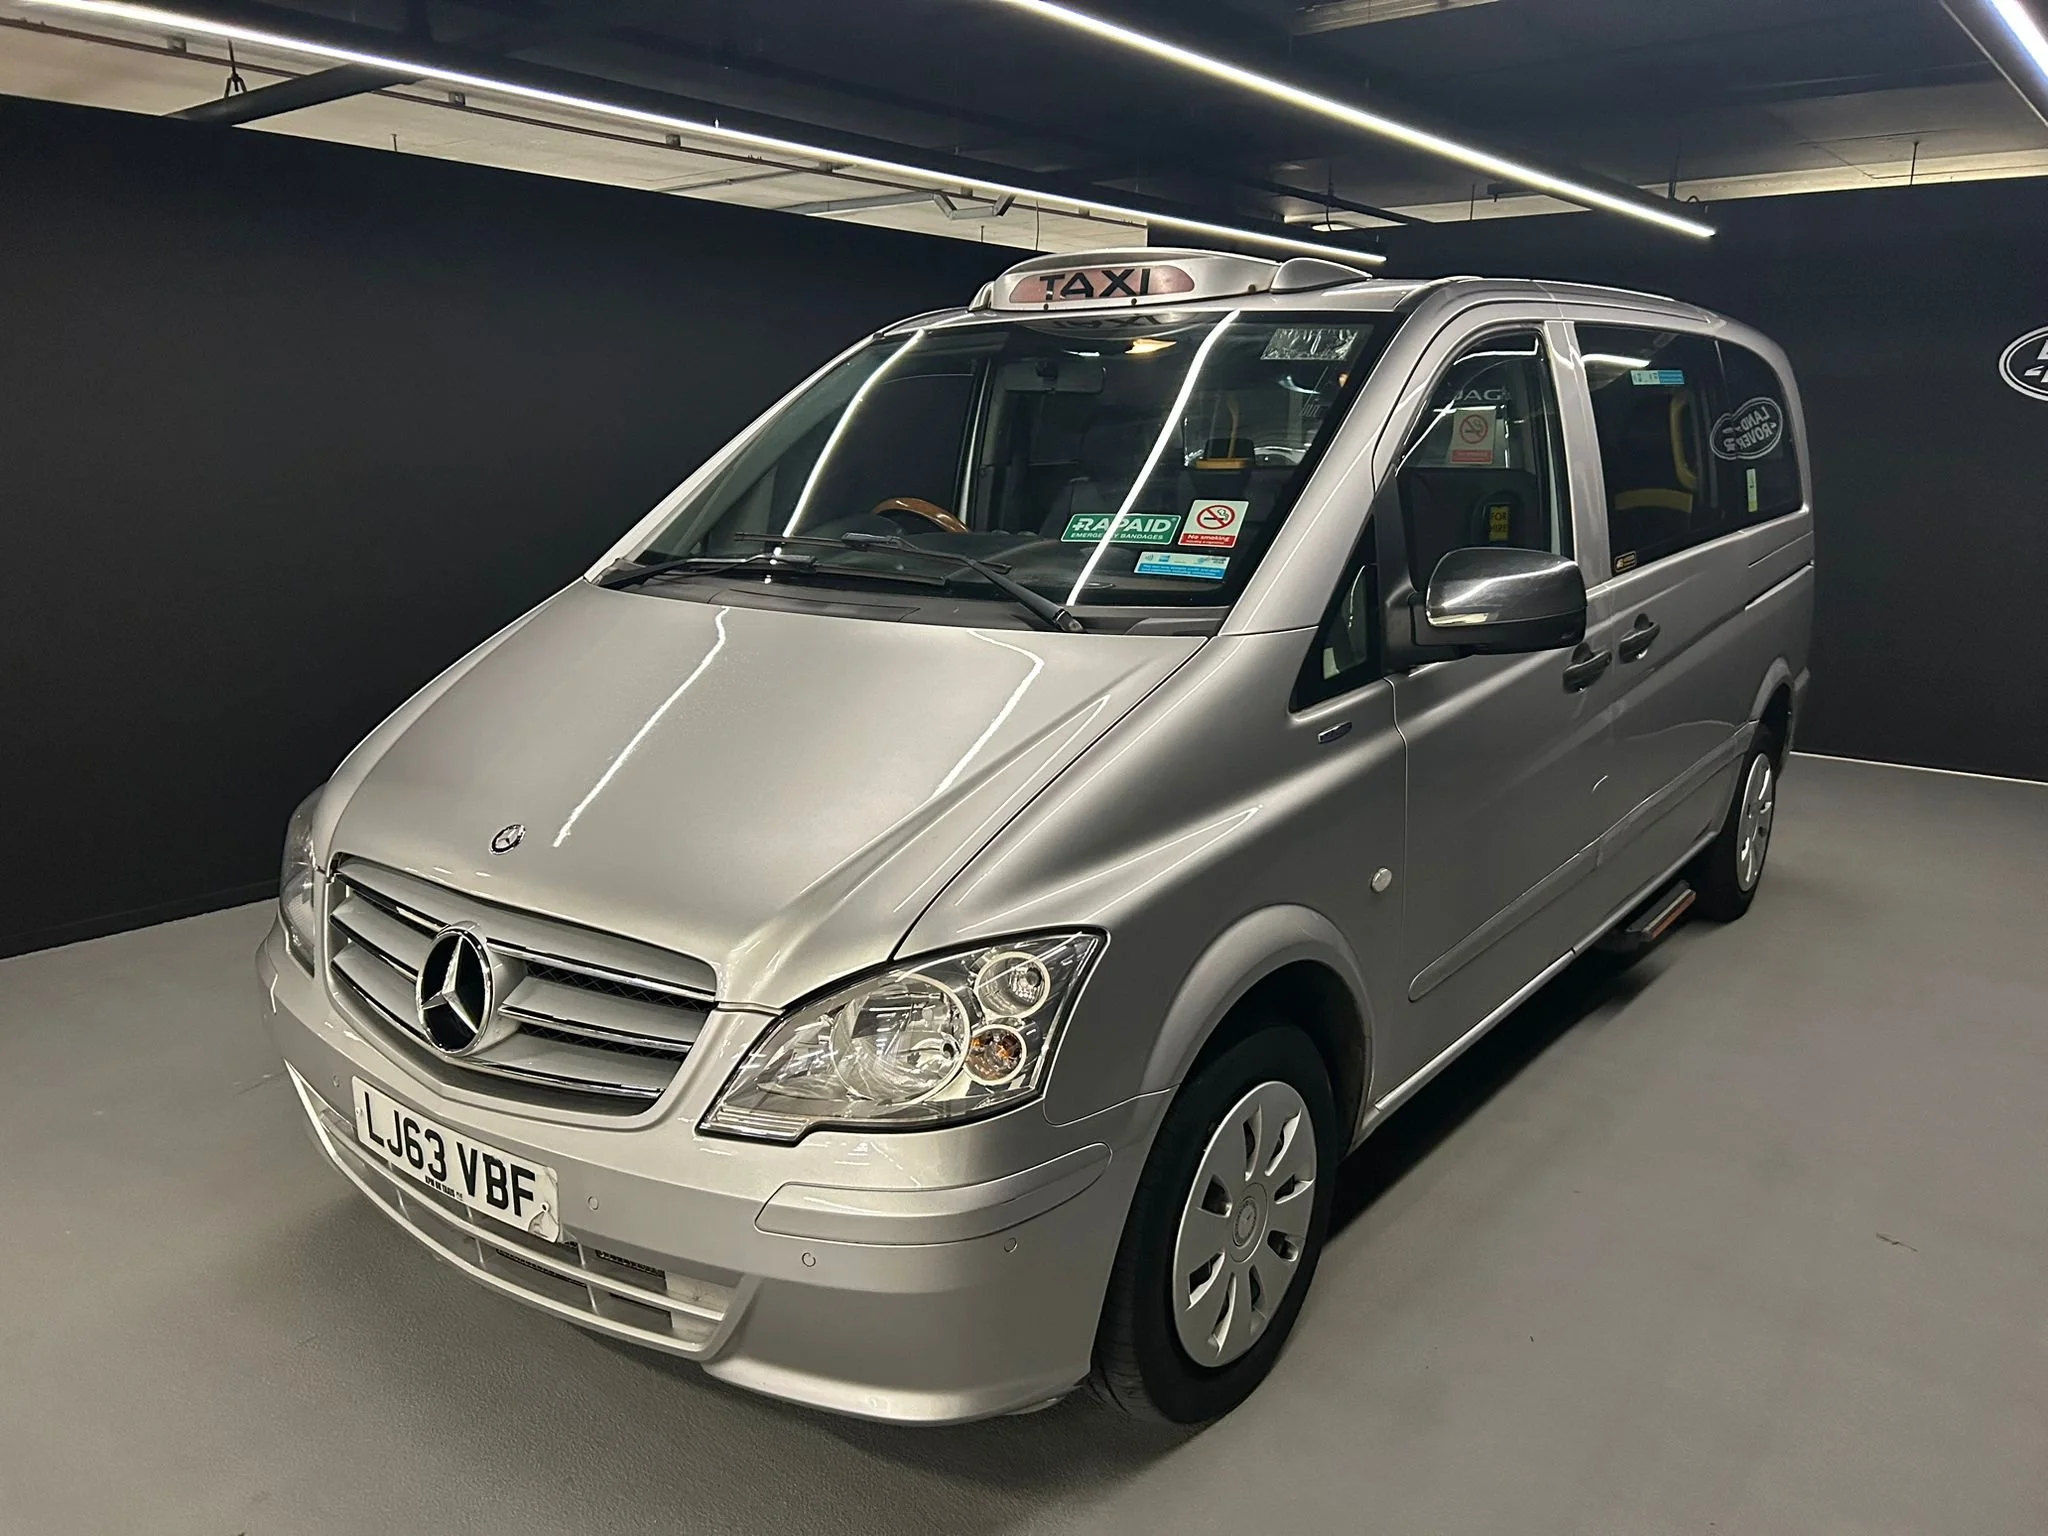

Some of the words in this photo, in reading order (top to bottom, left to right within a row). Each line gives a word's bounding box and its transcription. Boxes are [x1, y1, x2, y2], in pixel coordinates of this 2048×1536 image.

[1039, 268, 1151, 301] TAXI
[1070, 532, 1120, 540] EMERGEY
[364, 1091, 447, 1183] LJ63
[455, 1141, 536, 1218] VBF
